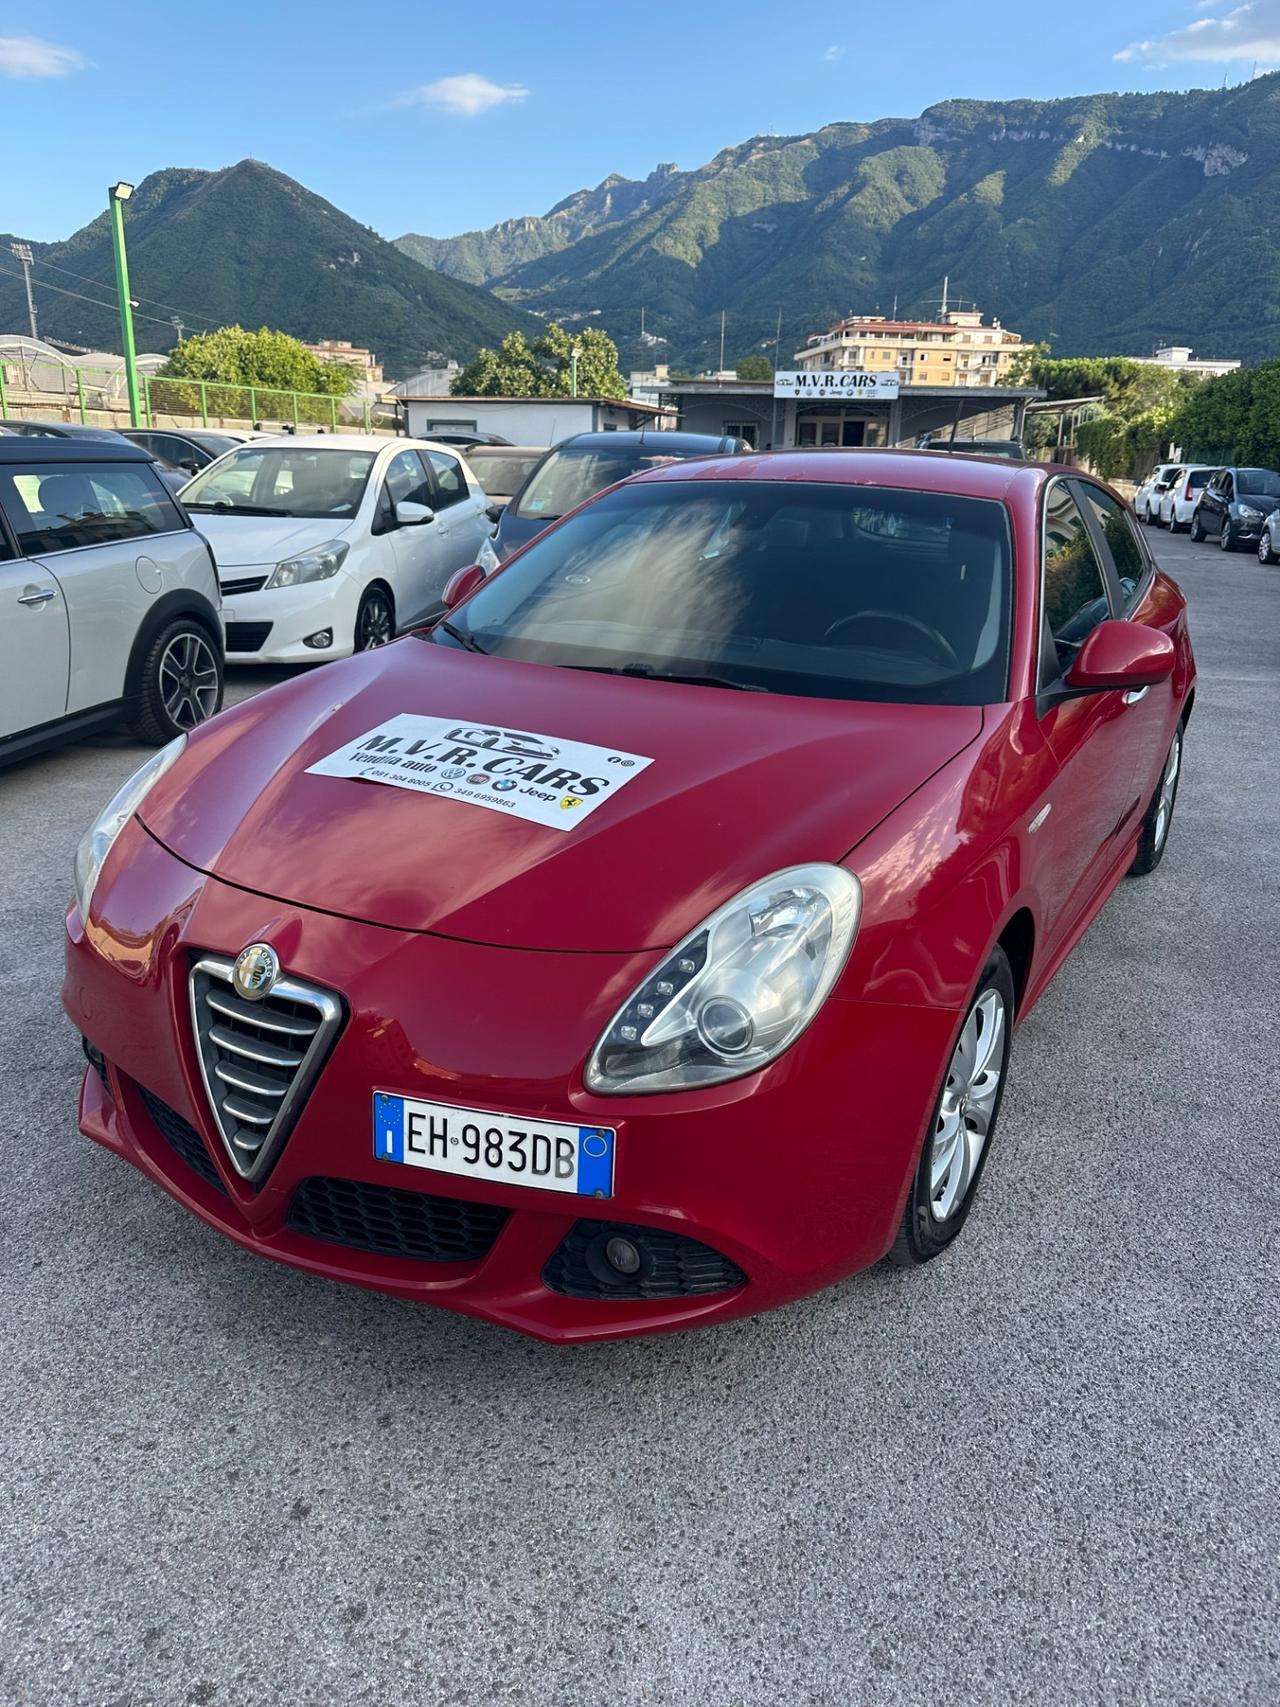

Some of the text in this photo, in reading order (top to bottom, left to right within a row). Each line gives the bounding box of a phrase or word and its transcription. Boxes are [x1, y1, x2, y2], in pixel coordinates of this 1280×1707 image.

[401, 759, 437, 773] auto
[371, 770, 516, 808] 081 304 8005 349 6959863
[519, 787, 557, 802] Jeep
